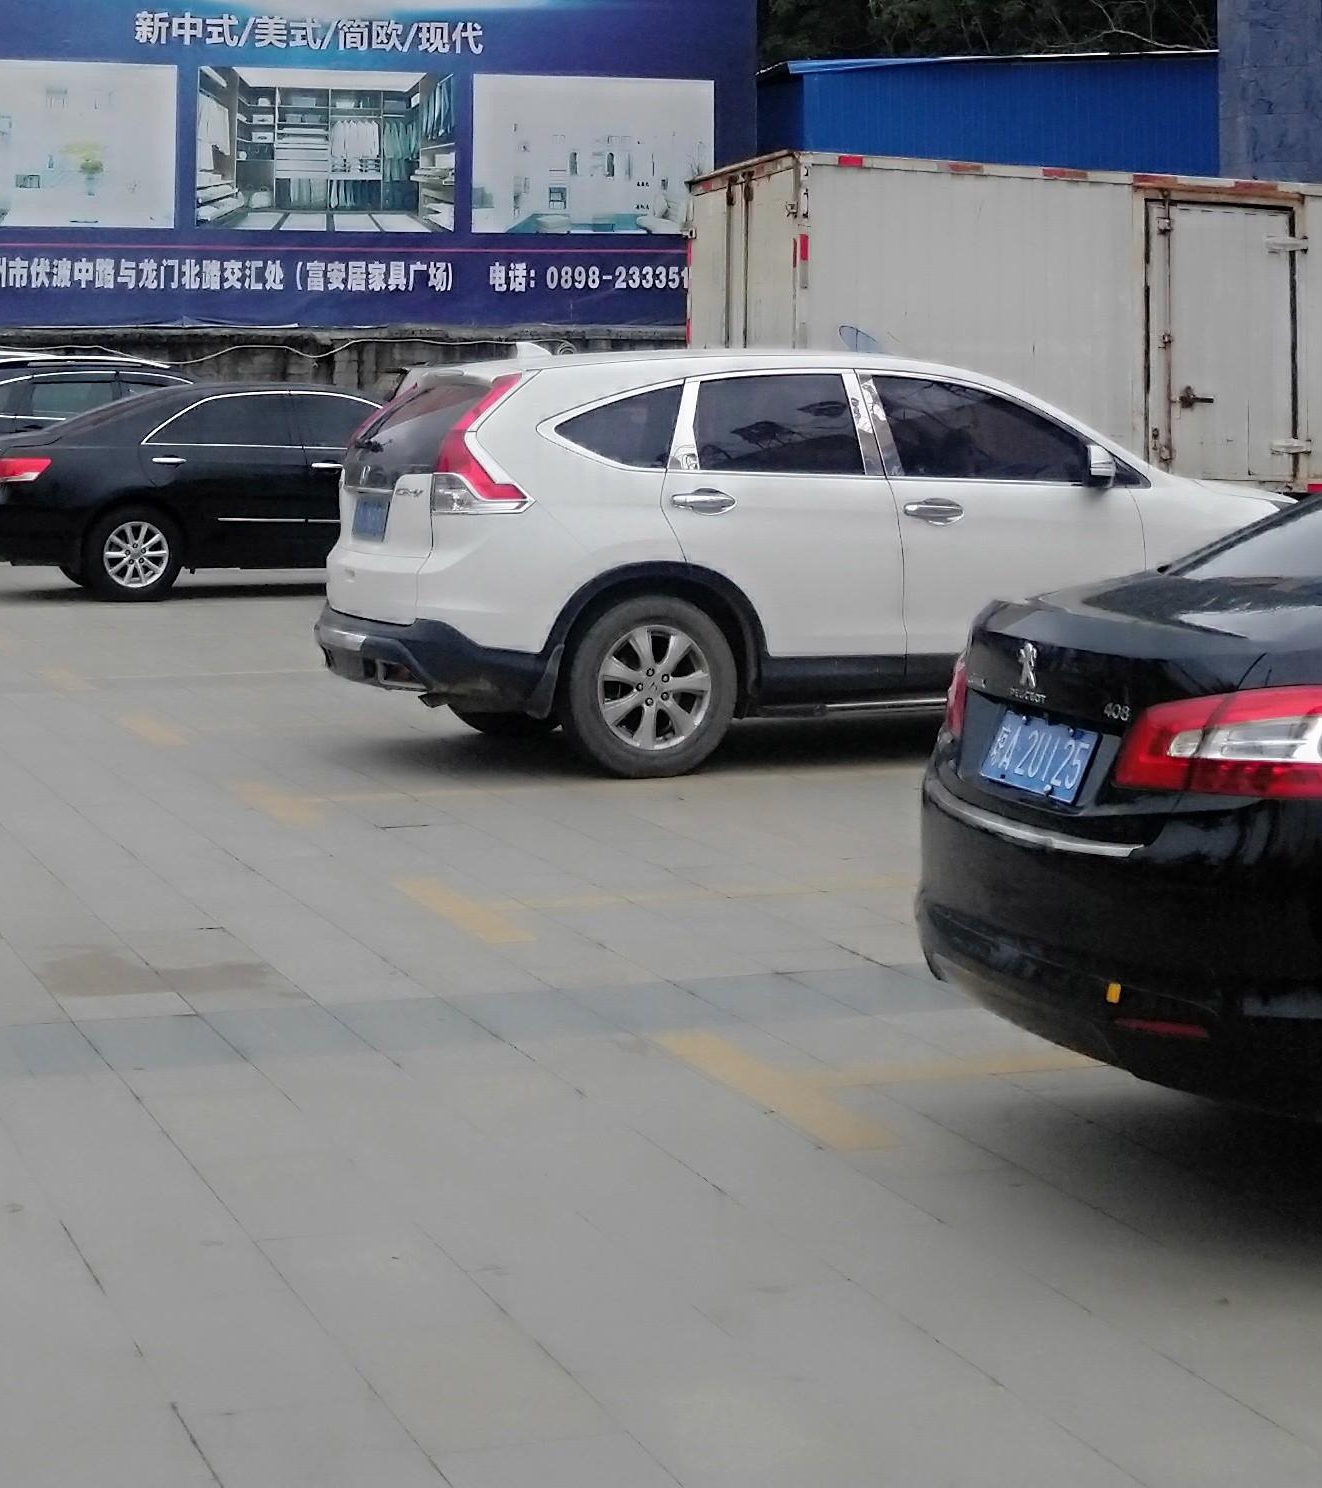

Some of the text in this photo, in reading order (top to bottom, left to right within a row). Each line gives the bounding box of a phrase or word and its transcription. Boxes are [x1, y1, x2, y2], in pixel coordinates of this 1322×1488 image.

[134, 11, 485, 55] 新中式/美式/简欧/现代
[1103, 702, 1132, 722] 408
